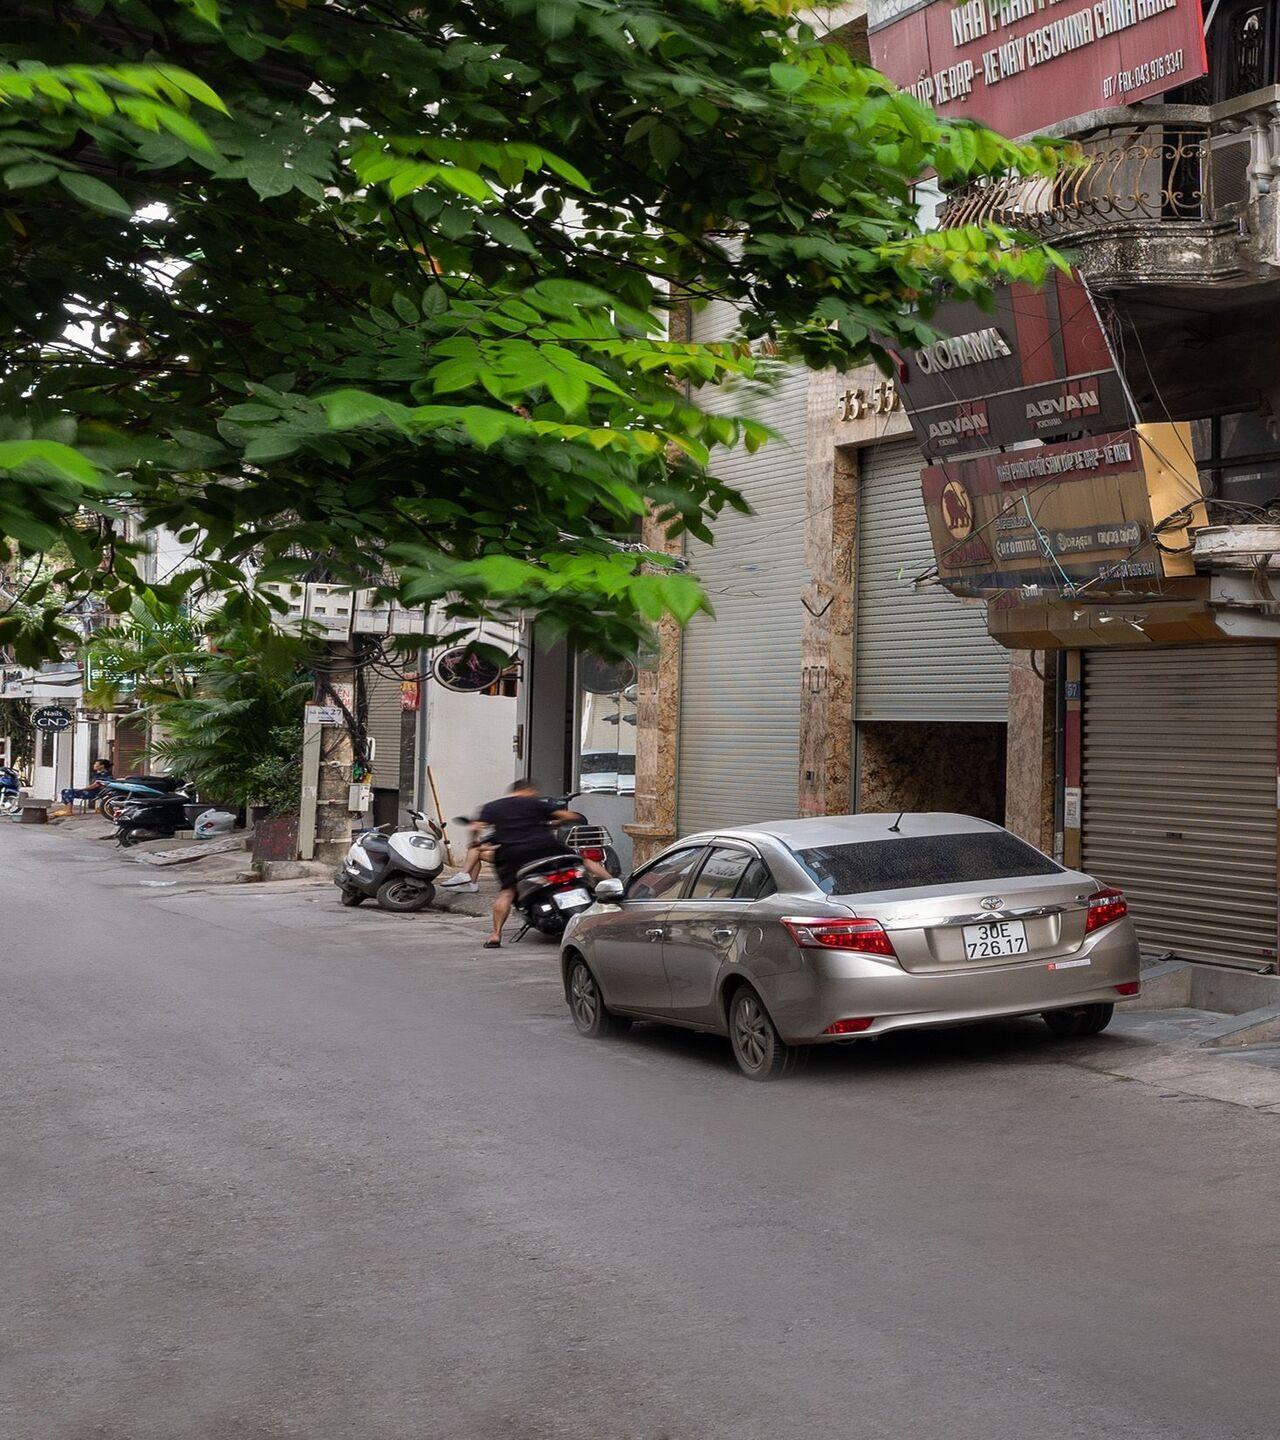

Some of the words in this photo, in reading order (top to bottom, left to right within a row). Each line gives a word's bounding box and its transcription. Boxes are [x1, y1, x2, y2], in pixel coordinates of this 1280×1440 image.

[933, 70, 950, 105] XE
[949, 60, 974, 102] ĐẠP
[982, 49, 1000, 86] XE
[999, 35, 1026, 79] MÁY
[1026, 8, 1095, 67] CASUMINA
[1135, 63, 1150, 87] 043
[1150, 57, 1165, 80] 976
[1164, 49, 1184, 75] 3347
[1025, 391, 1099, 418] ADVAN
[929, 413, 989, 438] ADVAN
[37, 718, 68, 726] CND
[978, 922, 1011, 941] 30E
[967, 937, 1025, 959] 726.17
